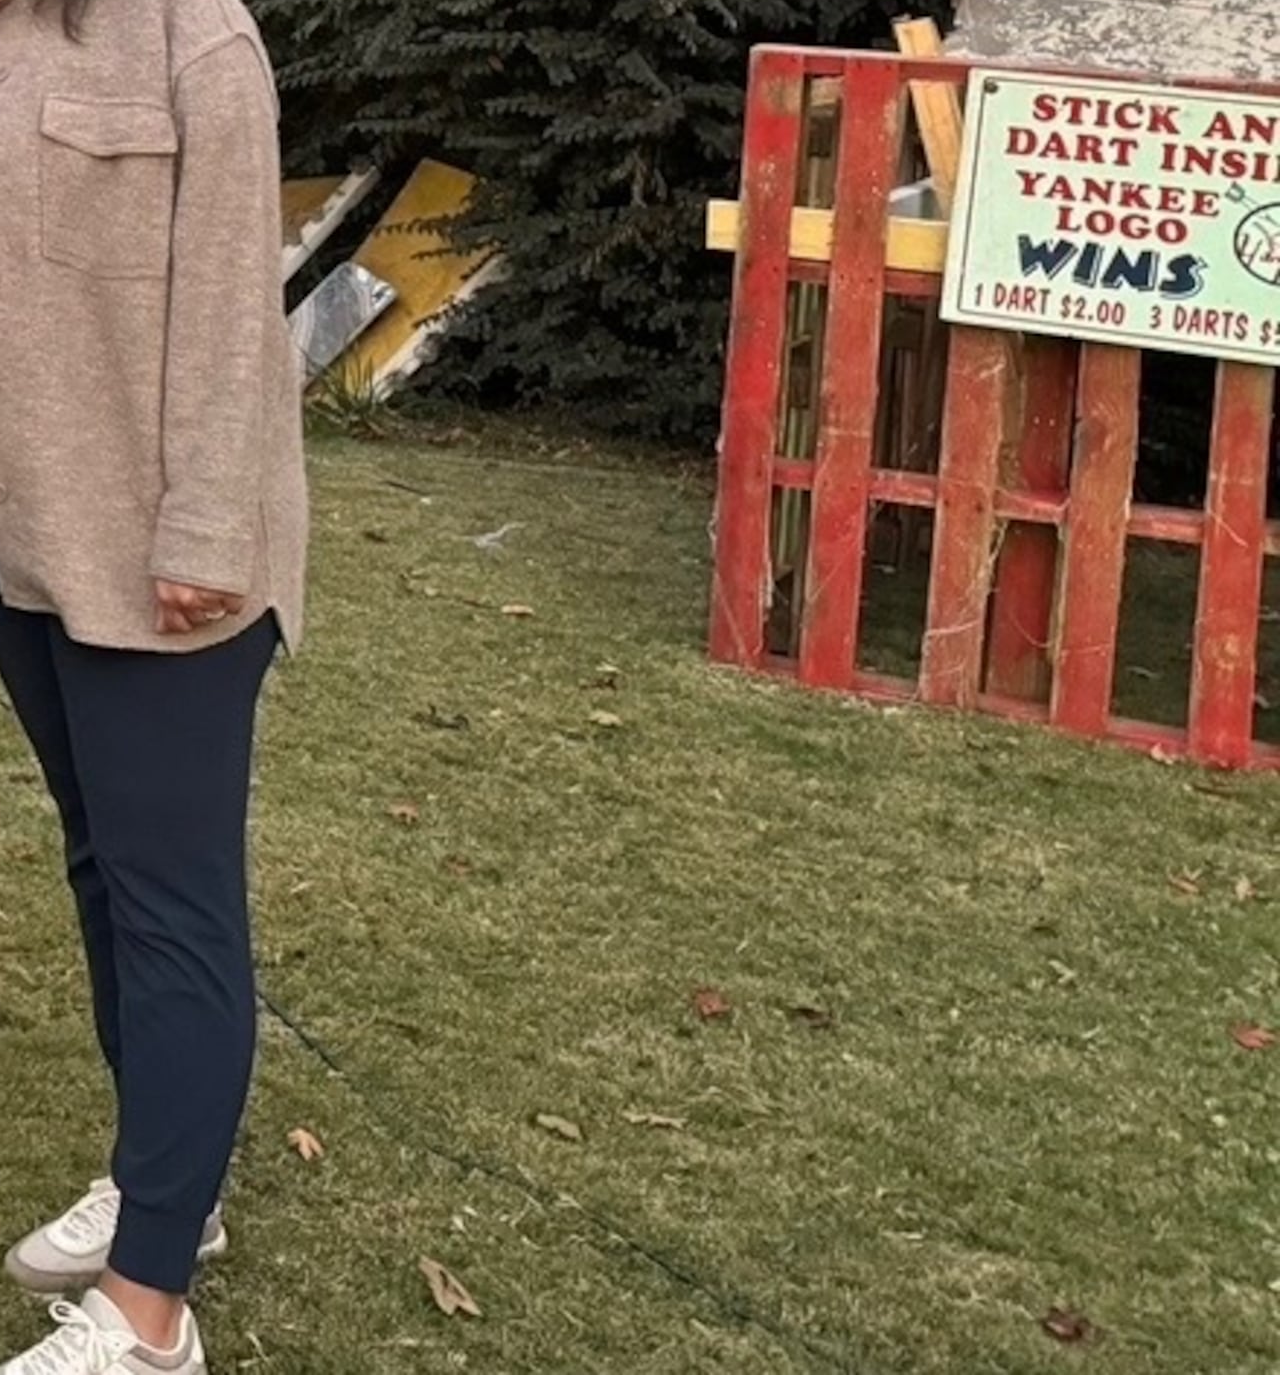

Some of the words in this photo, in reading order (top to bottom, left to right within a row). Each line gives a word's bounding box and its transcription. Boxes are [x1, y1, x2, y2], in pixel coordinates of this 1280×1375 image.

[1032, 94, 1182, 134] STICK
[1005, 127, 1139, 167] DART
[1160, 142, 1280, 184] INSI
[1016, 170, 1221, 217] YANKEE
[1055, 207, 1188, 244] LOGO
[1017, 234, 1208, 301] WINS
[974, 283, 984, 307] 1
[992, 283, 1052, 316] DART
[1060, 295, 1126, 325] $2.00
[1149, 305, 1162, 329] 3
[1173, 305, 1249, 342] DARTS
